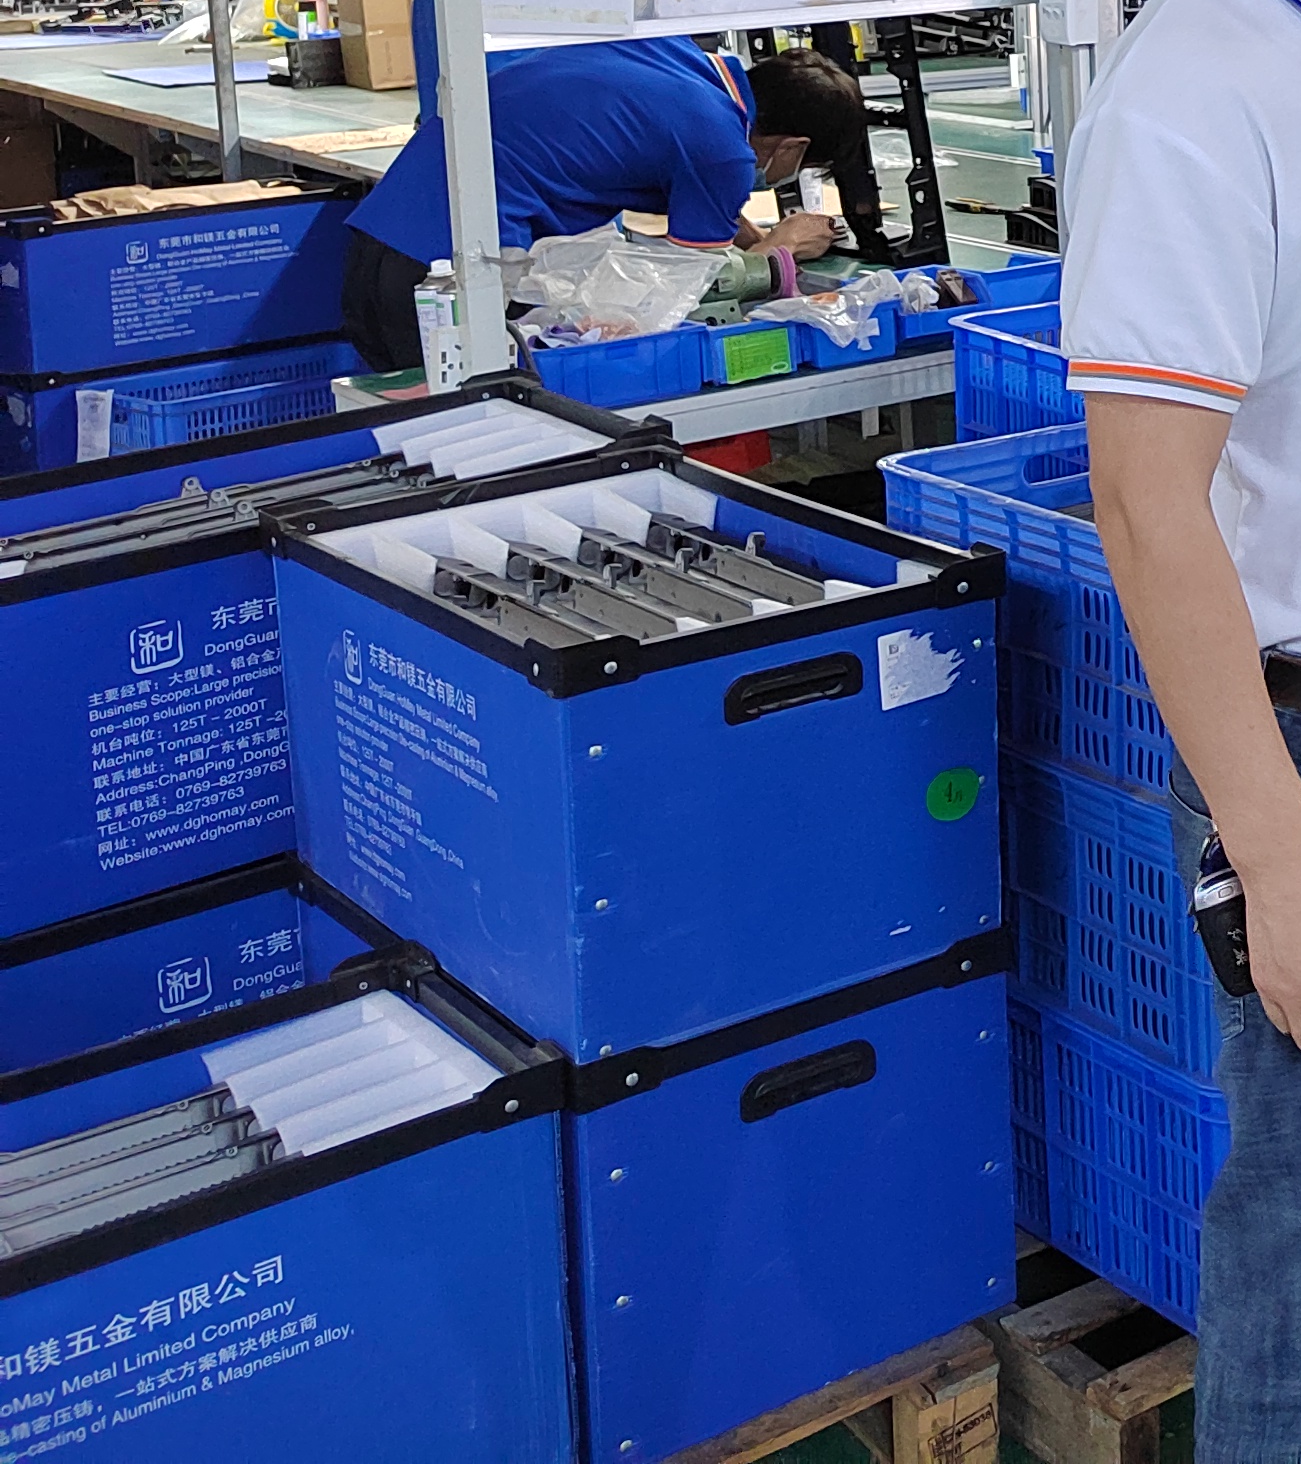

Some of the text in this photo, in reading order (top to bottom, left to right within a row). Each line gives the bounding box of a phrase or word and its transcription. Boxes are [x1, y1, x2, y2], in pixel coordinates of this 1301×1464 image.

[153, 701, 201, 722] solution
[205, 687, 254, 710] provider
[368, 642, 477, 722] 东莞市和镁五金有限公司
[89, 699, 147, 722] Business
[173, 715, 207, 733] 125T
[224, 699, 267, 720] 2000T
[93, 748, 154, 771] Machine
[157, 729, 223, 754] Tonnage:
[228, 715, 262, 734] 125T
[145, 794, 279, 841] www.dghomay.com
[61, 1362, 118, 1396] Metal
[123, 1332, 196, 1373] Limited
[201, 1297, 296, 1342] Company
[90, 1415, 107, 1434] of
[111, 1384, 197, 1426] Aluminium
[201, 1376, 214, 1392] &
[218, 1339, 310, 1385] Magnesium
